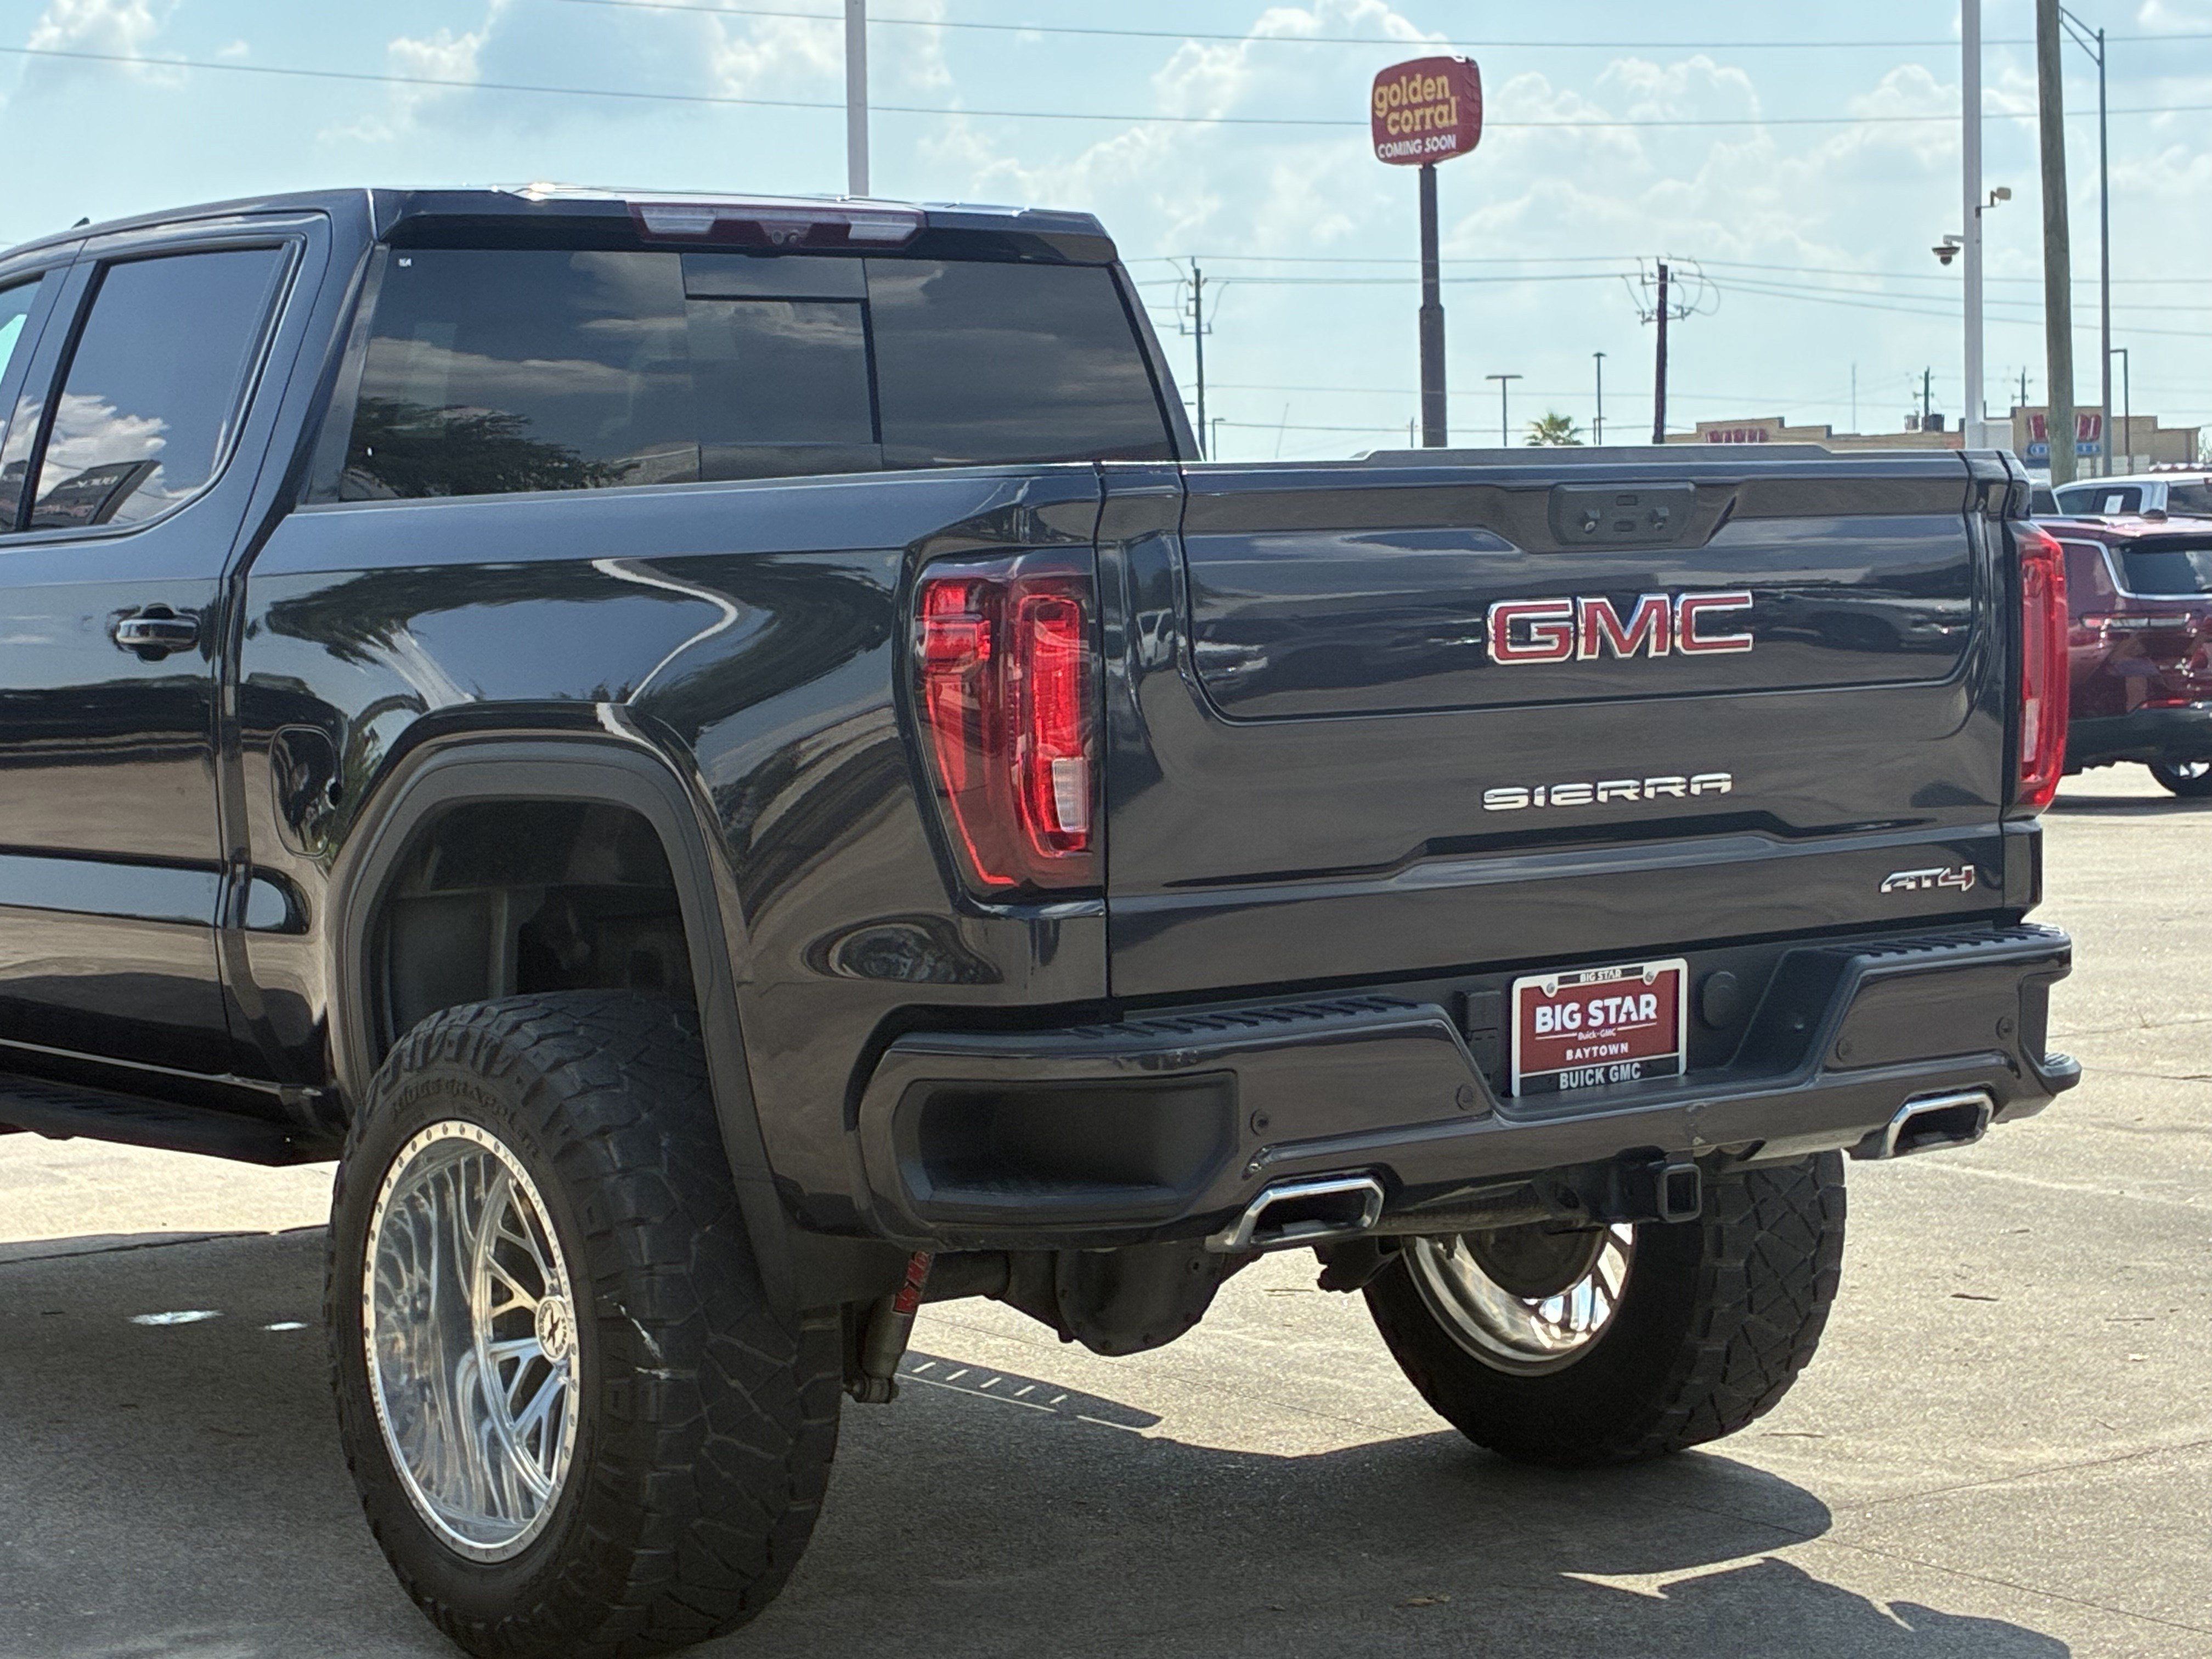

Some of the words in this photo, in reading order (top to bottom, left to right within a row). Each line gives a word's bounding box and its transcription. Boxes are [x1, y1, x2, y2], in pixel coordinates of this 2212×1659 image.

[1374, 74, 1449, 117] golden
[1387, 95, 1458, 135] corral
[1378, 139, 1423, 158] COMING
[1424, 134, 1456, 153] SOON
[1487, 590, 1753, 664] GMC
[1483, 772, 1732, 811] SIERRA
[1880, 865, 1975, 893] AT4
[1579, 972, 1596, 983] BIG
[1598, 969, 1622, 981] STAR
[1536, 1002, 1582, 1034] BIG
[1588, 994, 1657, 1026] STAR
[1566, 1042, 1629, 1060] BAYTOWN
[1560, 1068, 1605, 1090] BUICK
[1609, 1062, 1641, 1082] GMC
